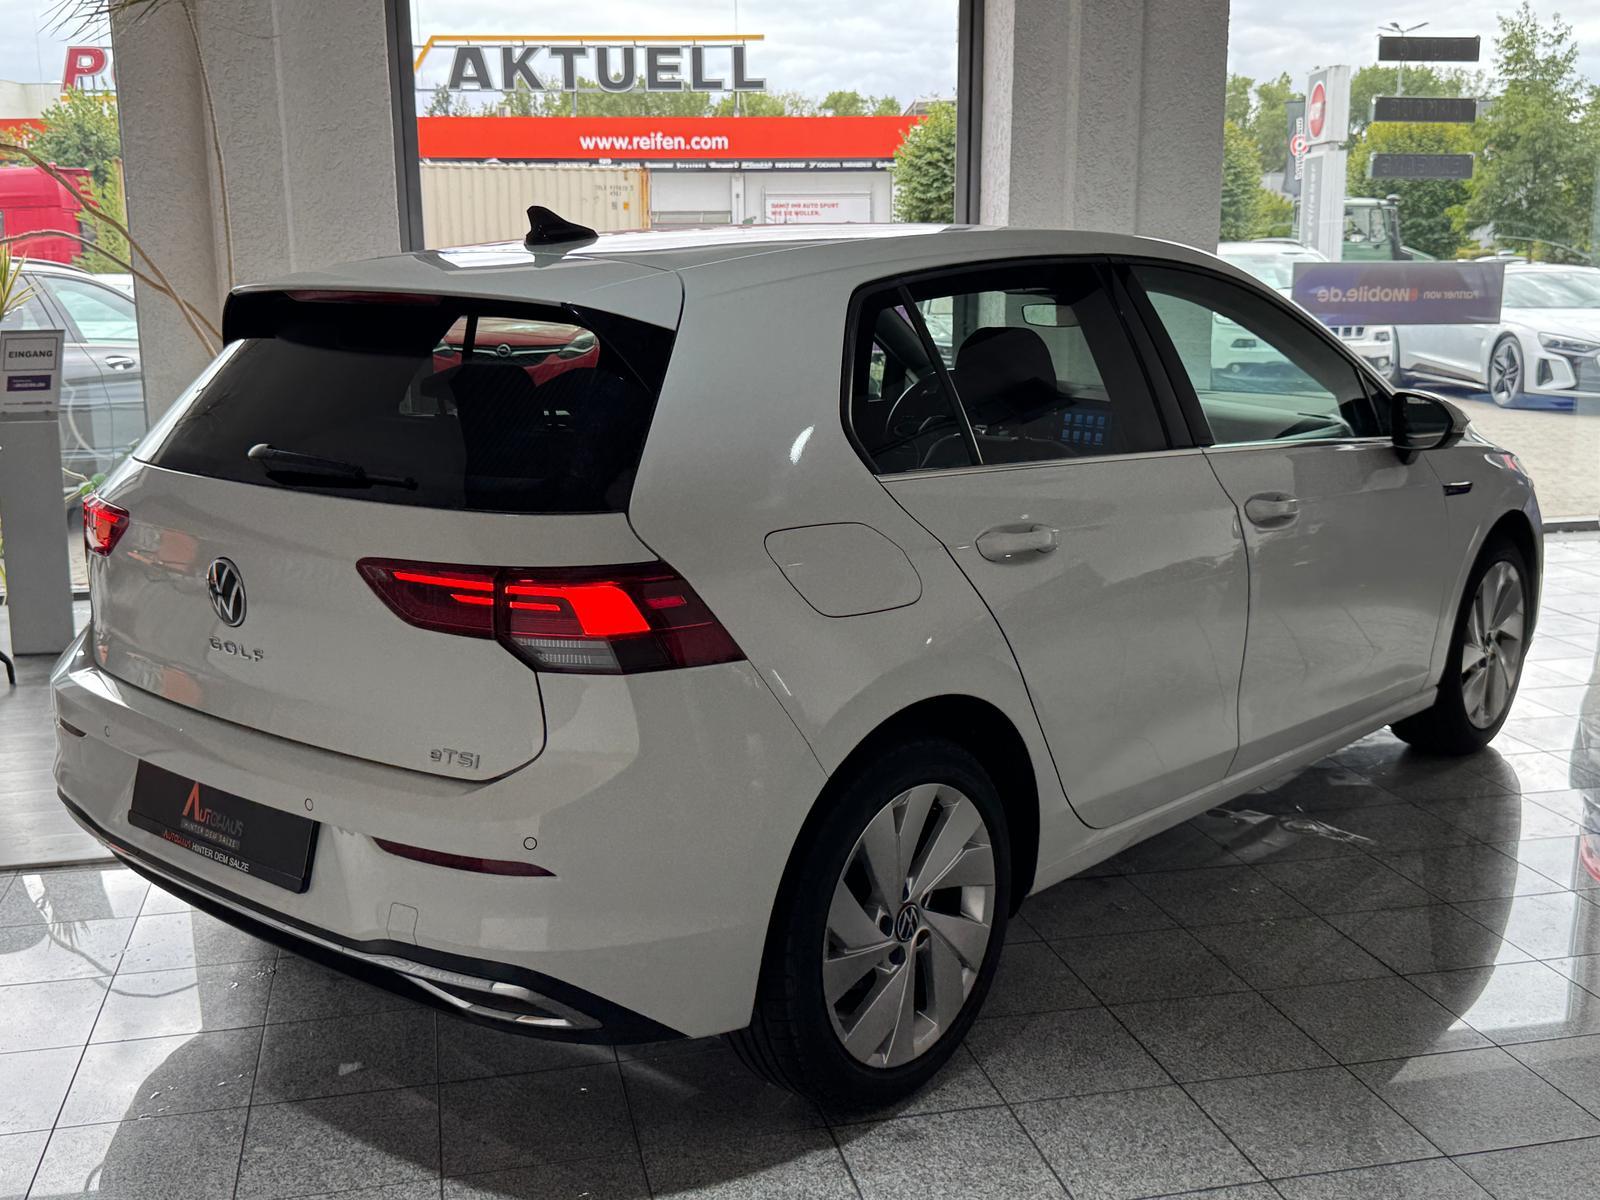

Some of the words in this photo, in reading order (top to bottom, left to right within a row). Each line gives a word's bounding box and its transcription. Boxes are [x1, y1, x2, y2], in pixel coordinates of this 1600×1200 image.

[61, 46, 115, 92] P
[448, 46, 767, 92] AKTUELL
[580, 132, 728, 151] www.reifen.com
[8, 350, 53, 359] EINGANG
[209, 636, 264, 662] GOLF
[430, 748, 481, 769] eTSI
[205, 829, 217, 840] DEM
[218, 834, 237, 848] SALZE
[191, 843, 213, 859] HINTER
[213, 850, 229, 864] DEM
[229, 856, 249, 872] SALZE
